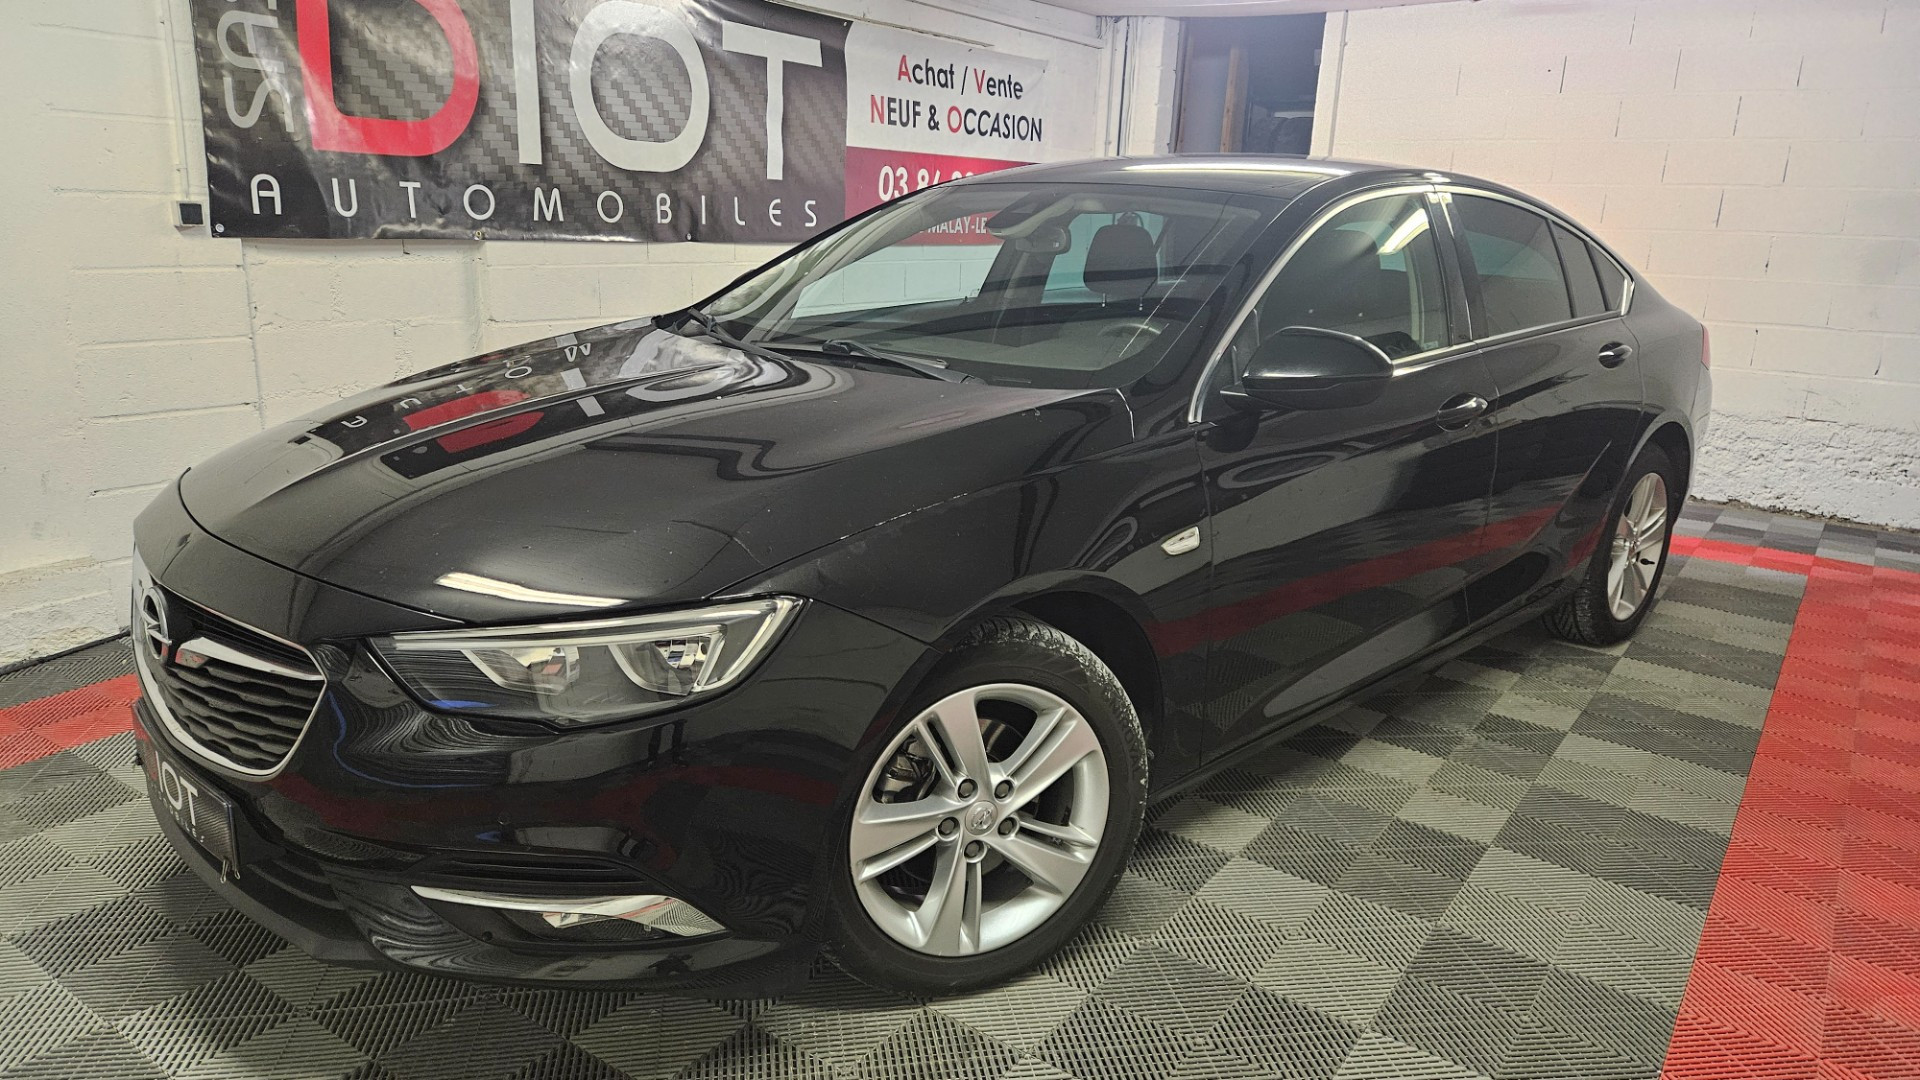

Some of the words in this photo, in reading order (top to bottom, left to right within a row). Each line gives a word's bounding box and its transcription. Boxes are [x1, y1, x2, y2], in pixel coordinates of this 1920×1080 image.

[217, 0, 295, 132] SA
[296, 0, 823, 181] DIOT
[897, 54, 955, 90] Achat
[960, 65, 969, 96] /
[973, 68, 1024, 101] Vente
[870, 94, 922, 128] NEUF
[927, 104, 940, 132] &
[946, 105, 1043, 143] OCCASION
[250, 173, 817, 228] AUTOMOBILES
[878, 165, 909, 202] 03
